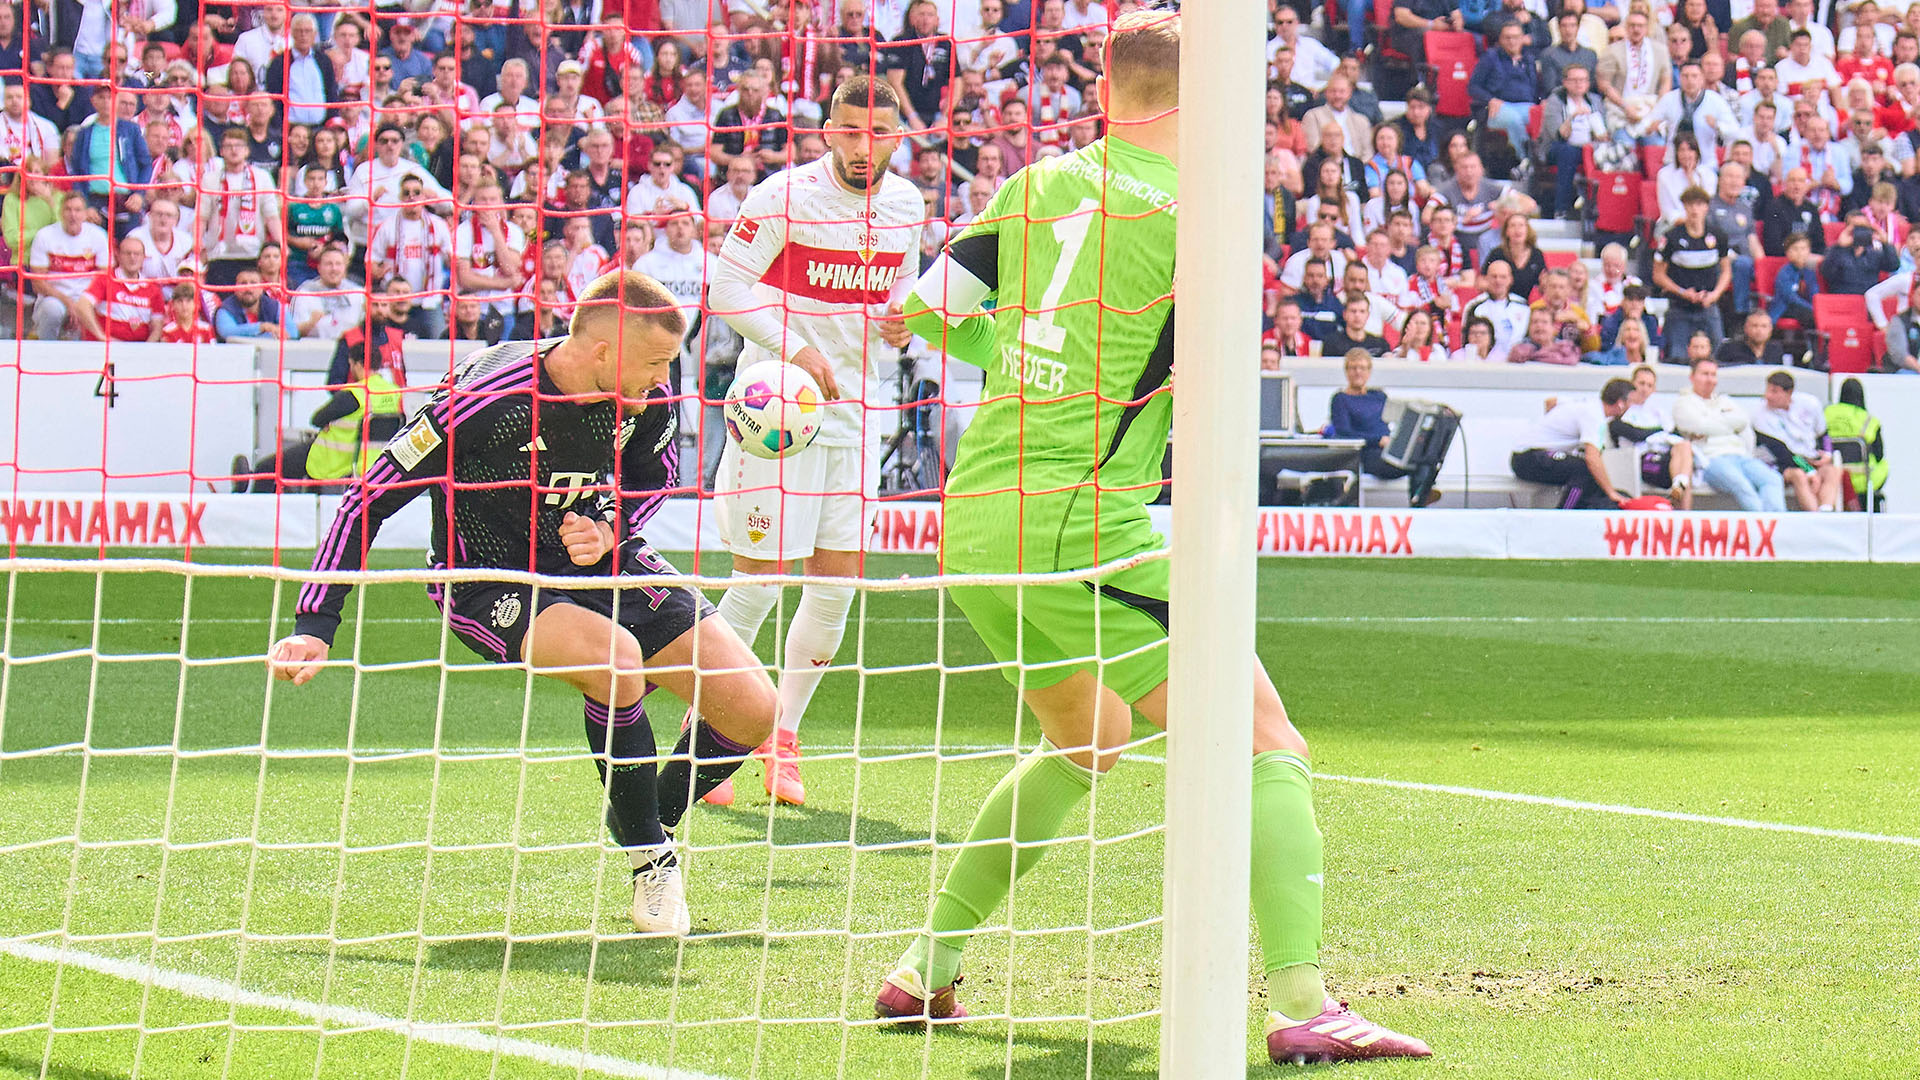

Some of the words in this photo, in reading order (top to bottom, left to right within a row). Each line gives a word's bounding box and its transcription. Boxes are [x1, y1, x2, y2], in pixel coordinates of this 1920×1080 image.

[1017, 197, 1100, 354] 1
[94, 363, 119, 408] 4
[1001, 343, 1069, 395] NEUER
[0, 500, 206, 545] WINAMAX
[1604, 517, 1777, 557] WINAMAX
